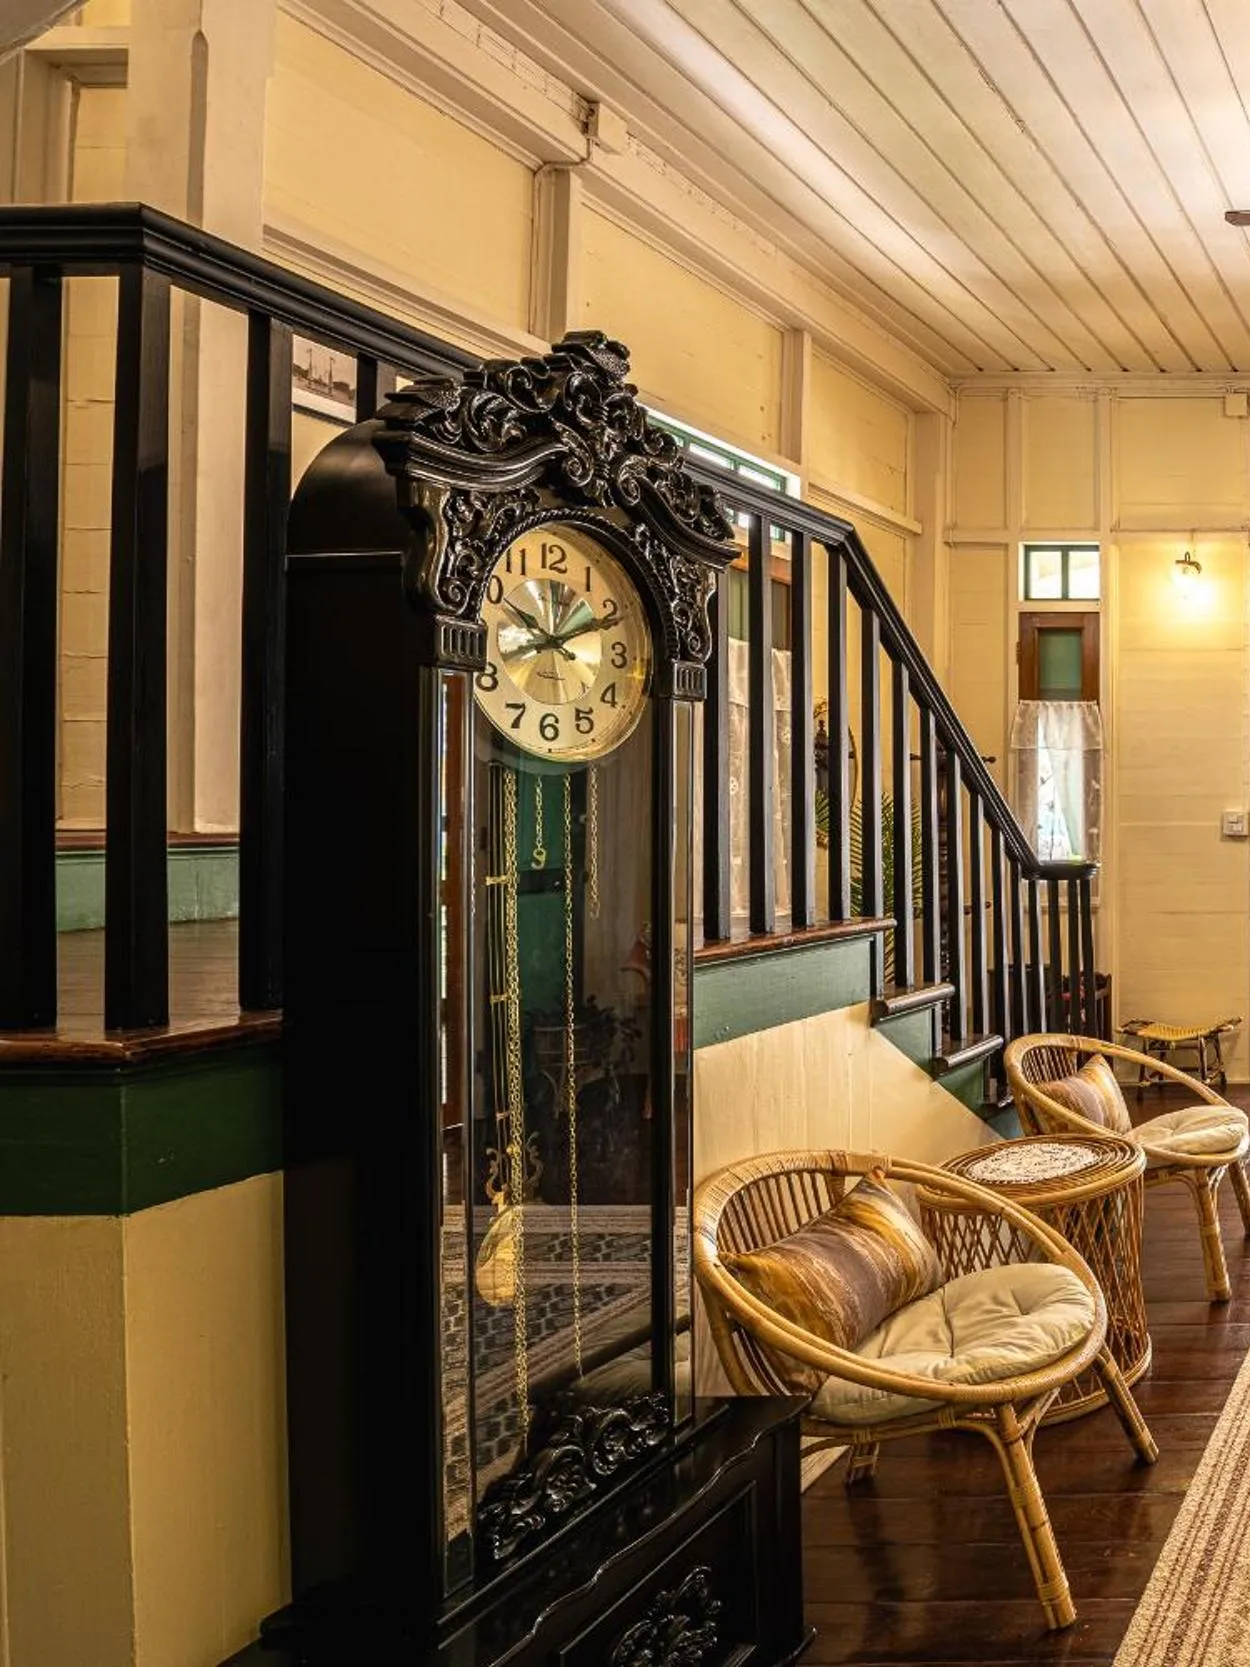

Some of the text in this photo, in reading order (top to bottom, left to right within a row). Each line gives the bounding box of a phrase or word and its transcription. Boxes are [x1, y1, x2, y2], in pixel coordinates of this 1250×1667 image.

[505, 547, 527, 576] 11
[540, 542, 568, 574] 12
[486, 574, 504, 604] 0
[583, 566, 592, 592] 1
[602, 598, 619, 624] 2
[610, 641, 628, 669] 3
[475, 662, 499, 692] 8
[599, 681, 620, 708] 4
[504, 702, 526, 729] 7
[539, 713, 560, 742] 6
[574, 706, 595, 735] 5
